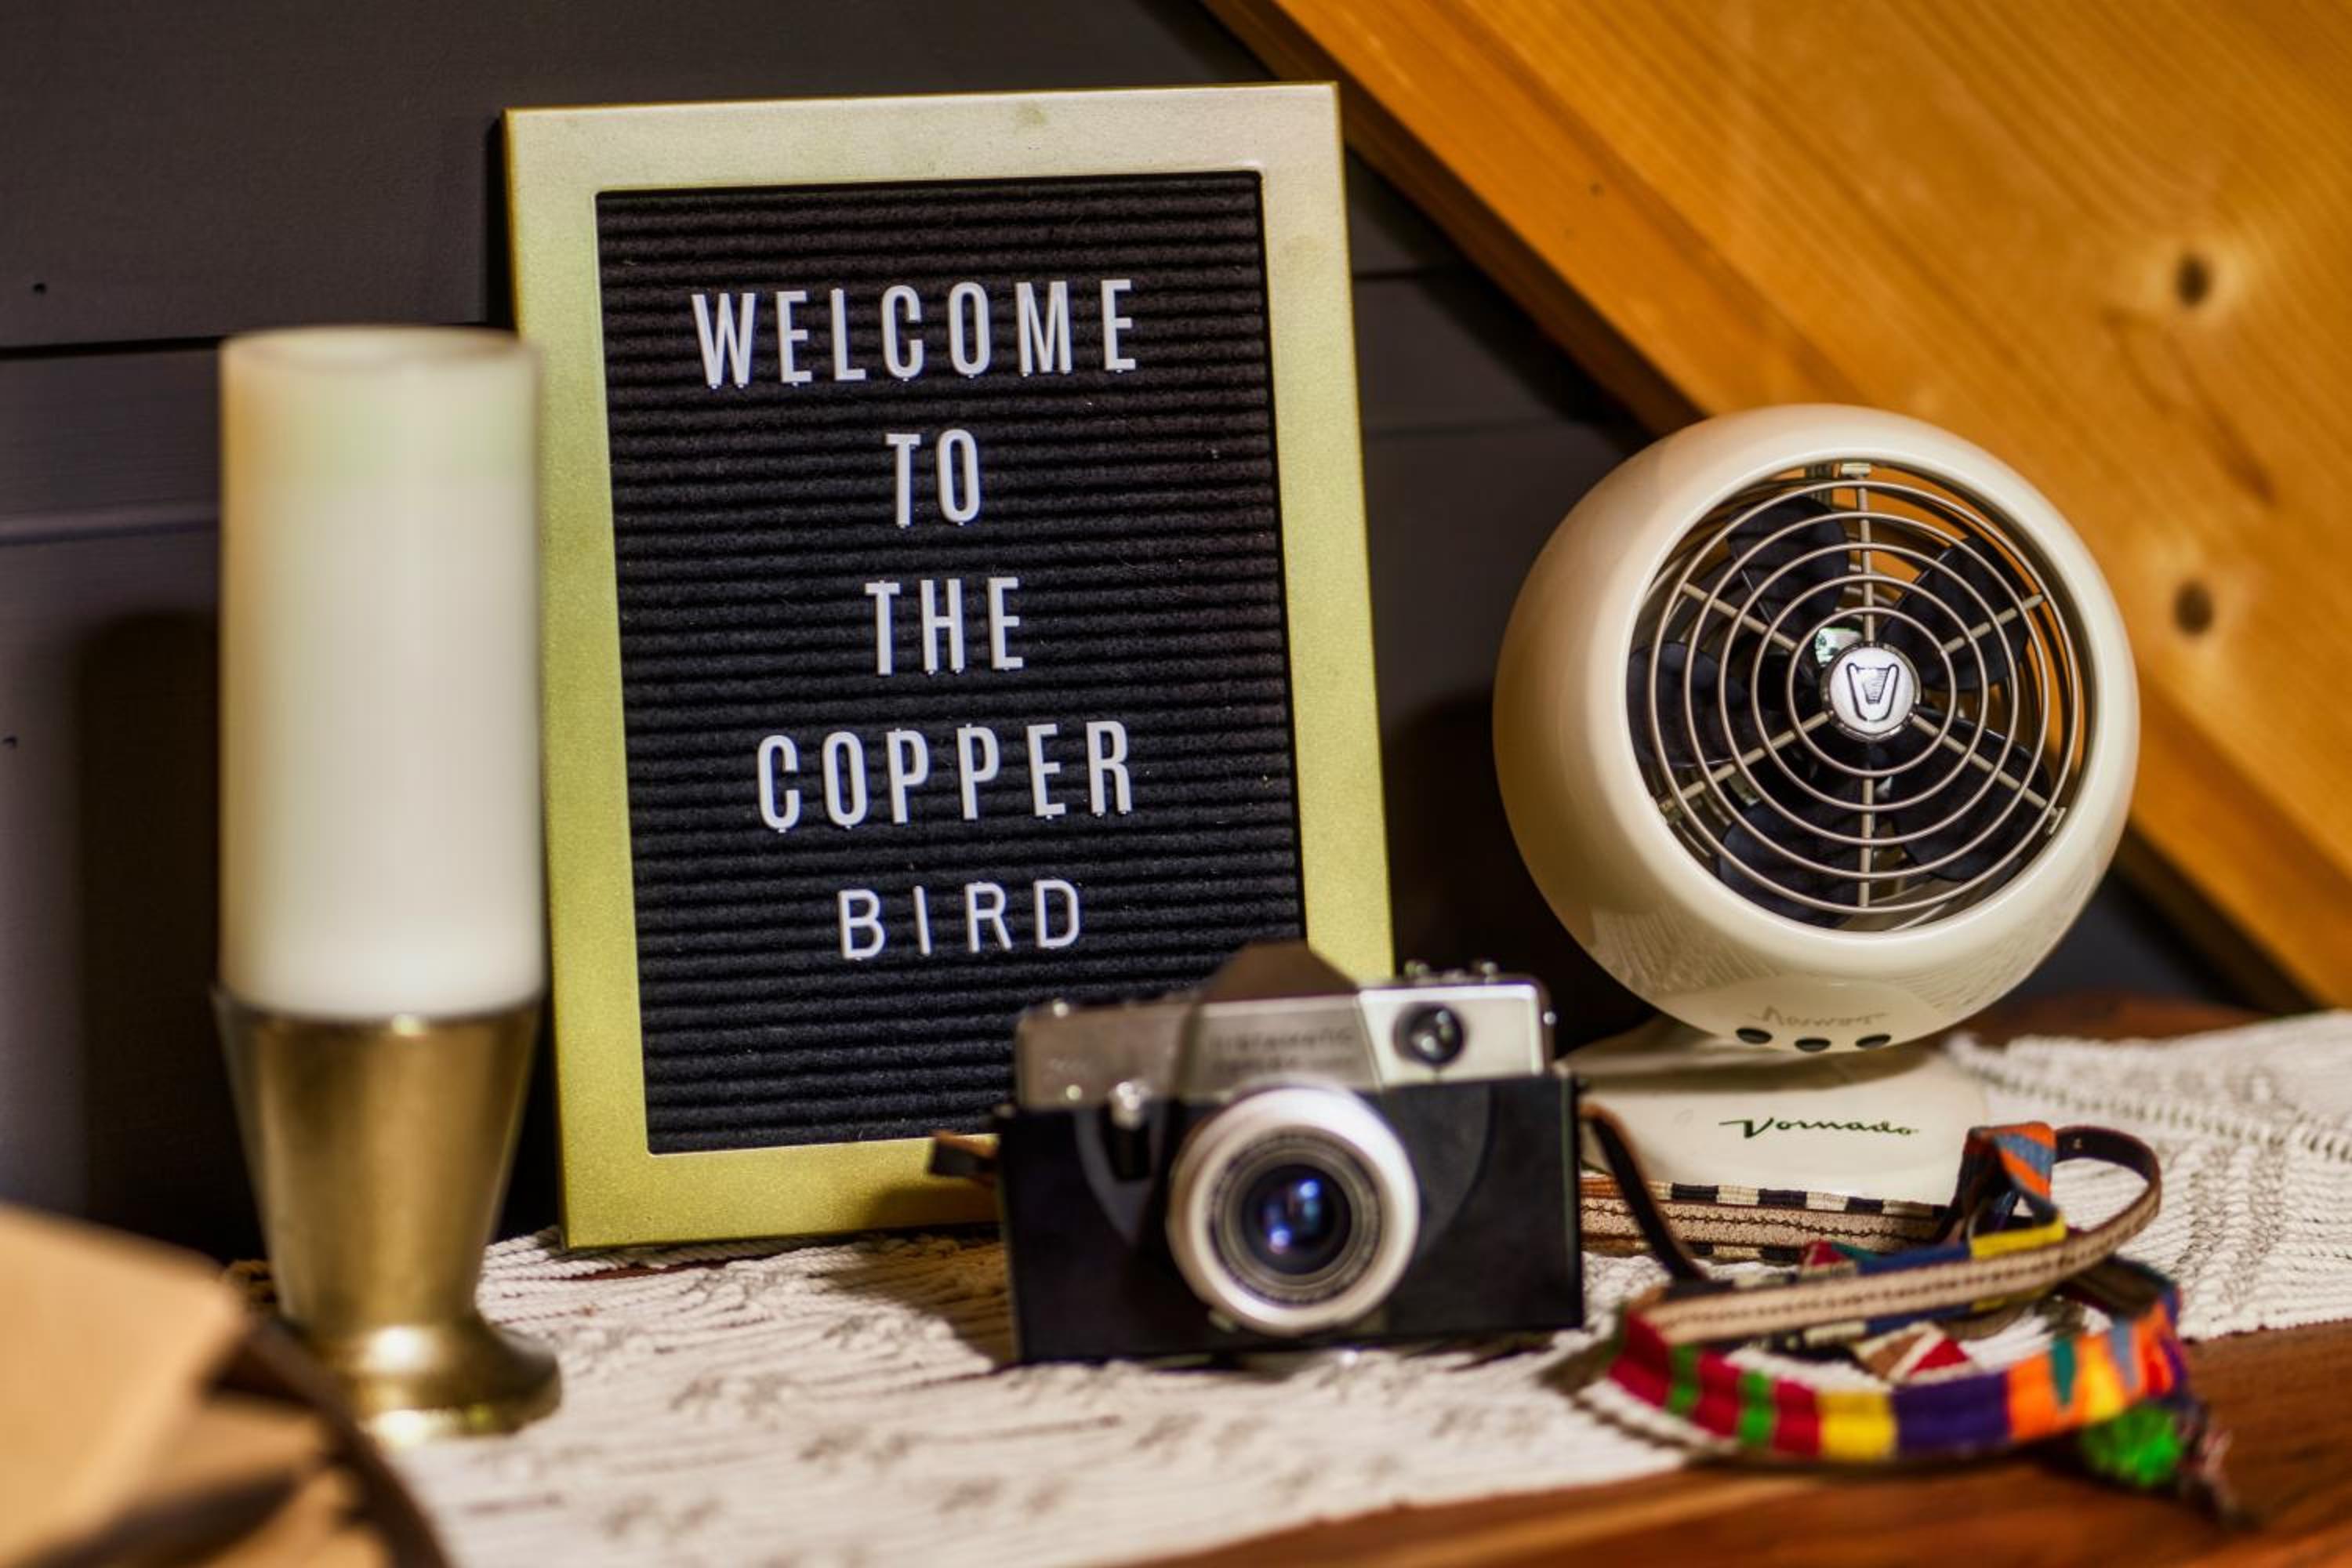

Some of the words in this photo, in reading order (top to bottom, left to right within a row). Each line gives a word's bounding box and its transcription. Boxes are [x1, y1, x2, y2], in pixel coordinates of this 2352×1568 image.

[691, 278, 1136, 389] WELCOME
[886, 429, 980, 528] TO
[865, 577, 1023, 675] THE
[757, 720, 1132, 833] COPPER
[838, 879, 1080, 960] BIRD
[1719, 1117, 1916, 1138] Vornado
